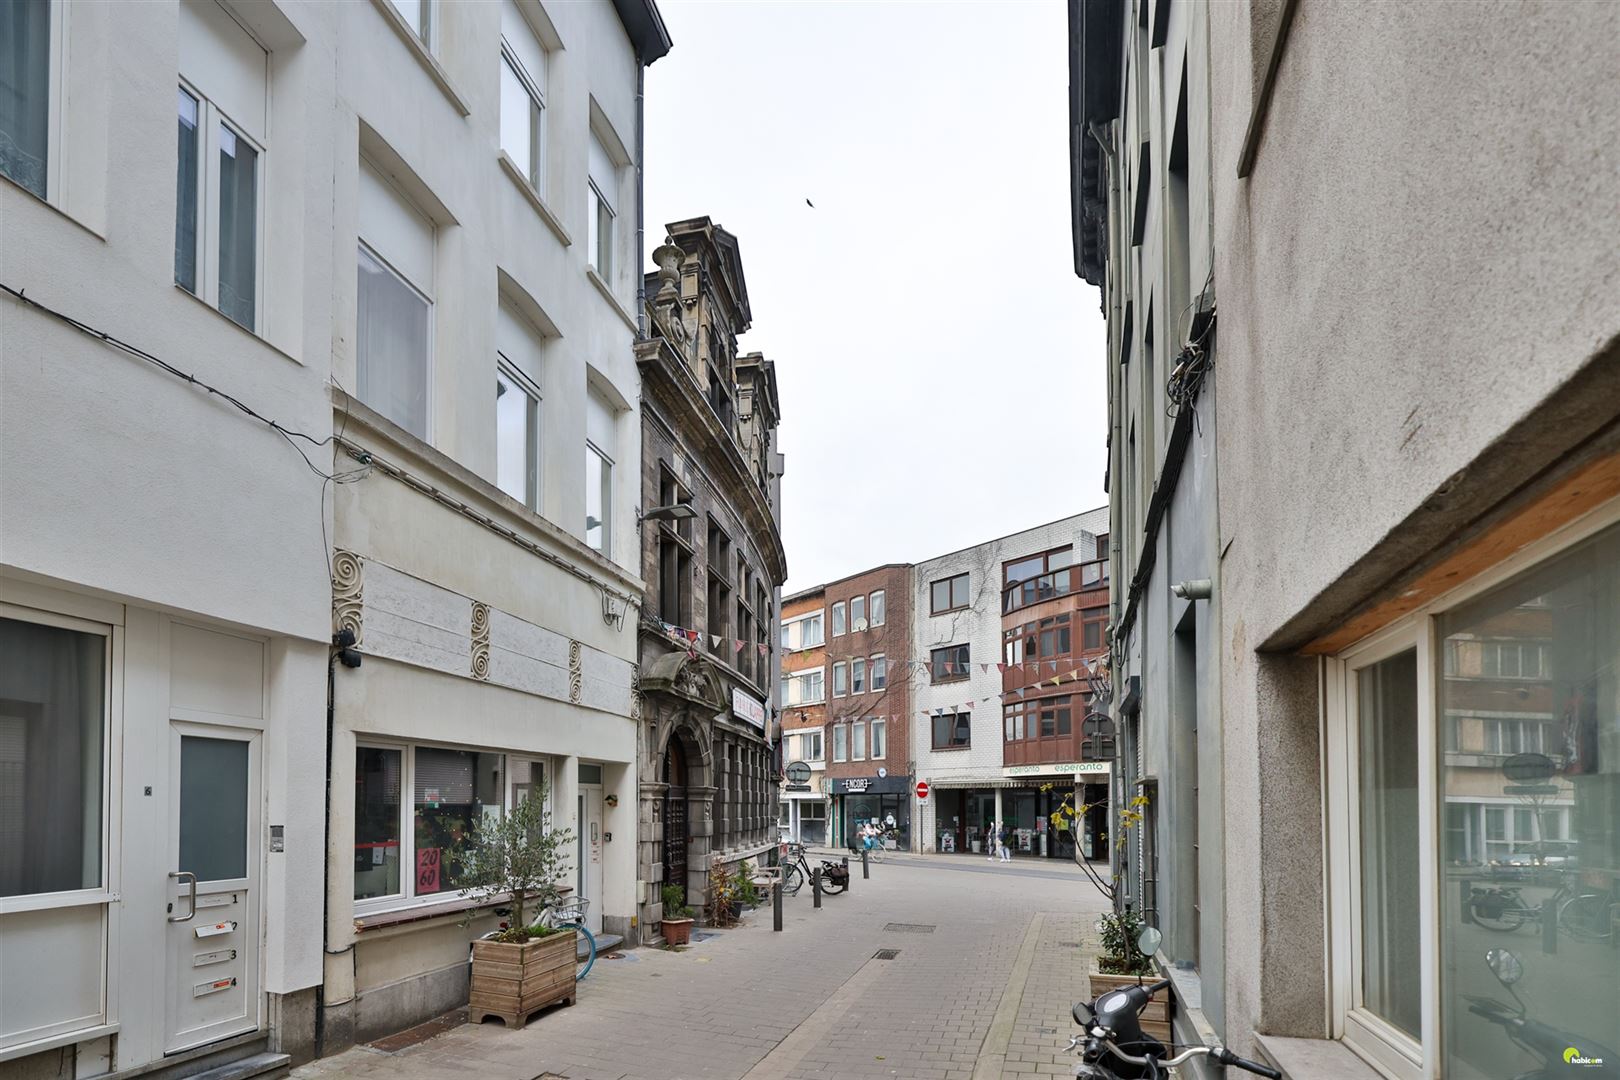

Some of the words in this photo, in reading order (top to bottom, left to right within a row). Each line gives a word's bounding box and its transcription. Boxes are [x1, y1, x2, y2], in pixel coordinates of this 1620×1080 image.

[1055, 763, 1103, 773] esperanto
[421, 849, 438, 866] 20
[420, 869, 435, 886] 60
[232, 894, 238, 904] 1
[230, 949, 237, 960] 3
[231, 977, 237, 987] 4
